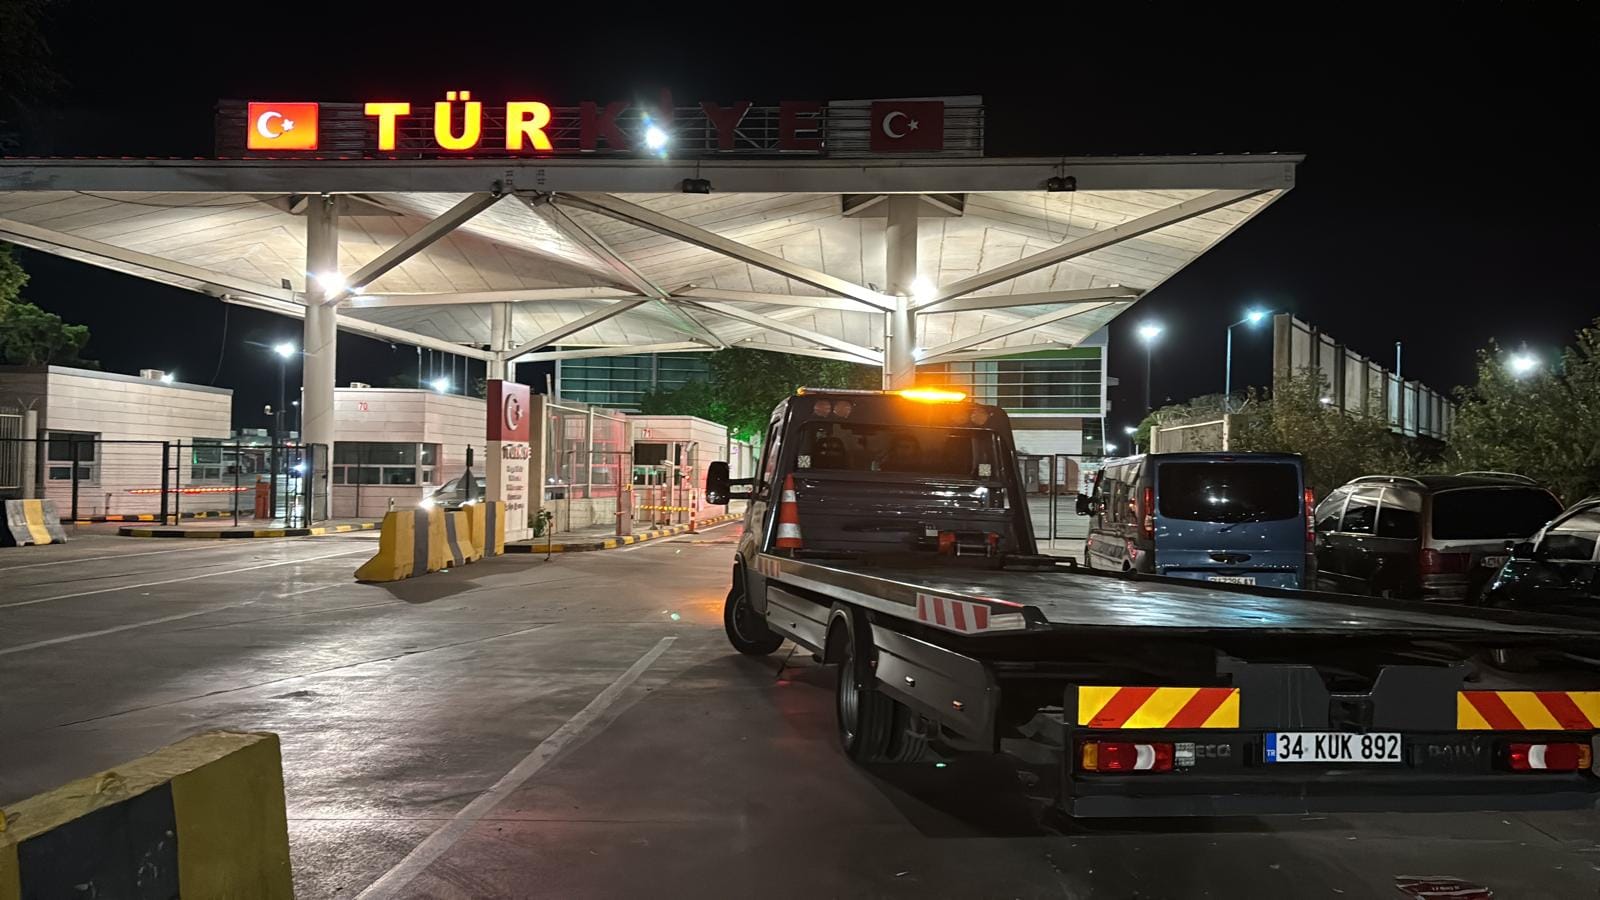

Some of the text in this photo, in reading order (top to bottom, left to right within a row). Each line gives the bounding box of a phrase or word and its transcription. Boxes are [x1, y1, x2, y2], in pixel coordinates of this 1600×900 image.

[1279, 735, 1398, 759] 34 KUK 892
